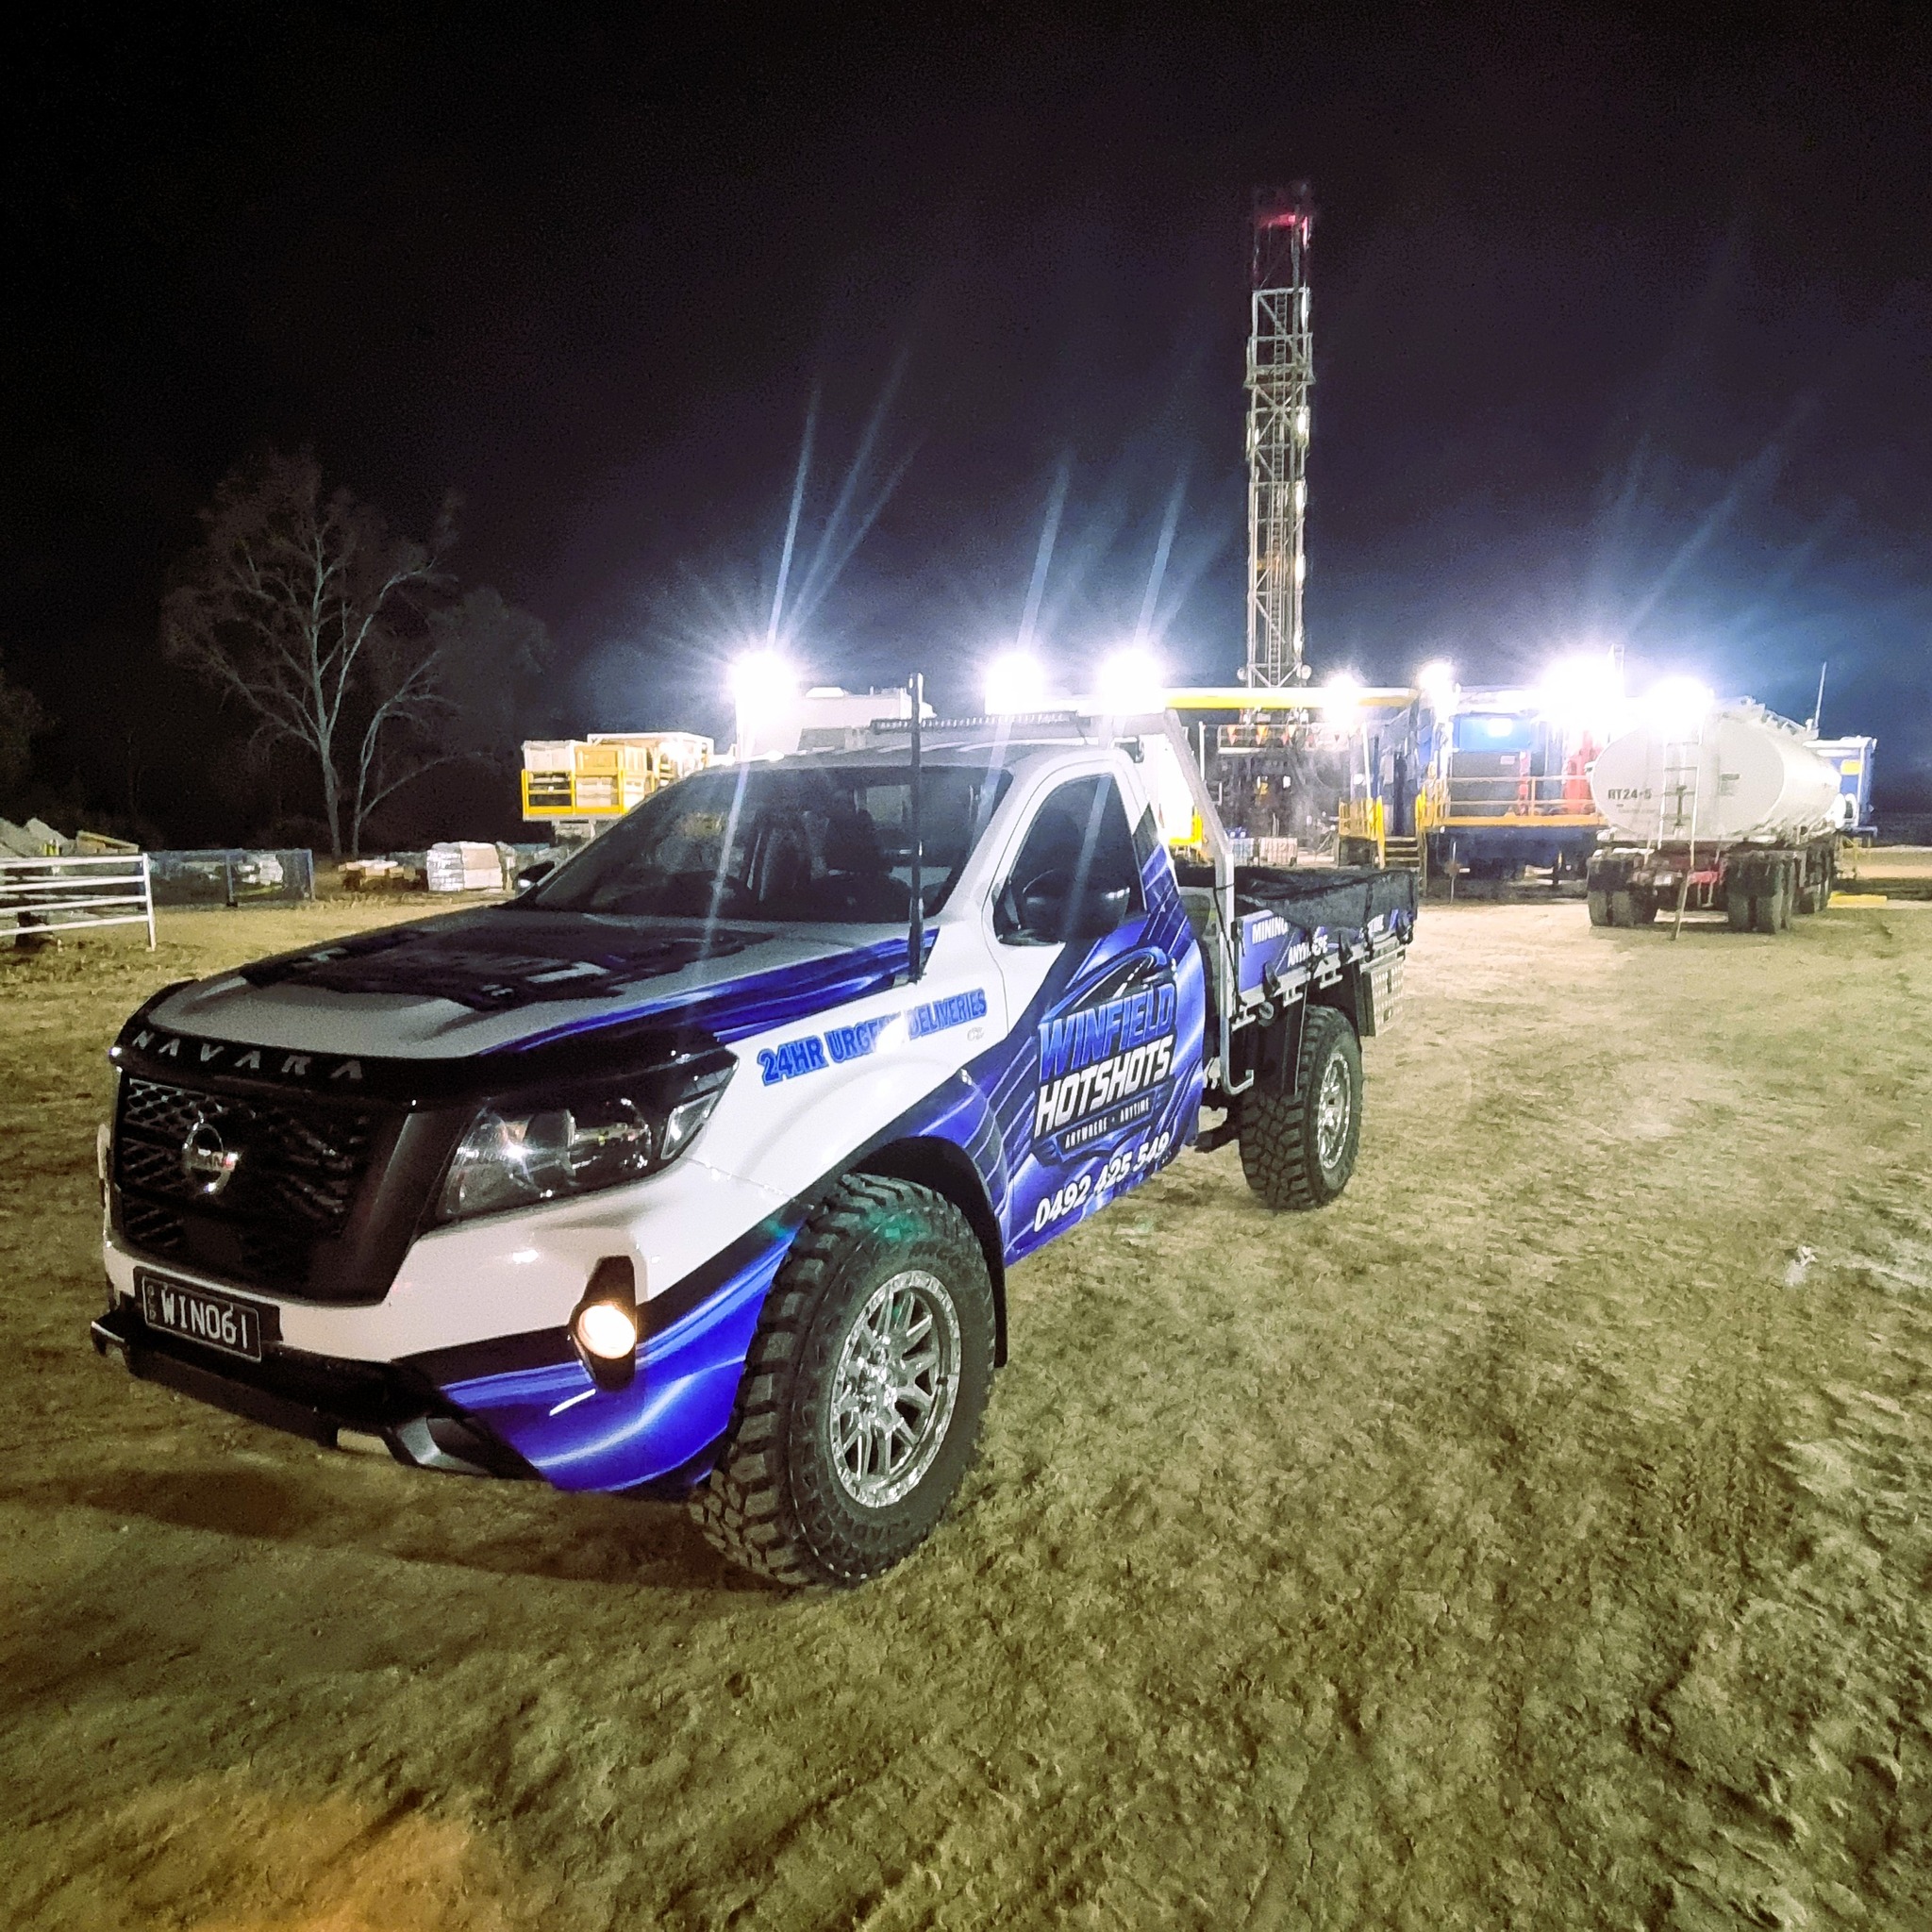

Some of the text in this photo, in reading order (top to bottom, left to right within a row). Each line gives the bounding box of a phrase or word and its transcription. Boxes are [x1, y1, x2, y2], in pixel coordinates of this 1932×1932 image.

[132, 1030, 363, 1079] NAVARA
[758, 1036, 829, 1086] 24HR
[908, 988, 988, 1041] DELIVERIES
[1039, 983, 1176, 1081] WINFIELD
[1034, 1035, 1174, 1138] HOTSHOTS
[1034, 1174, 1091, 1232] 0492
[1093, 1151, 1133, 1193] 425
